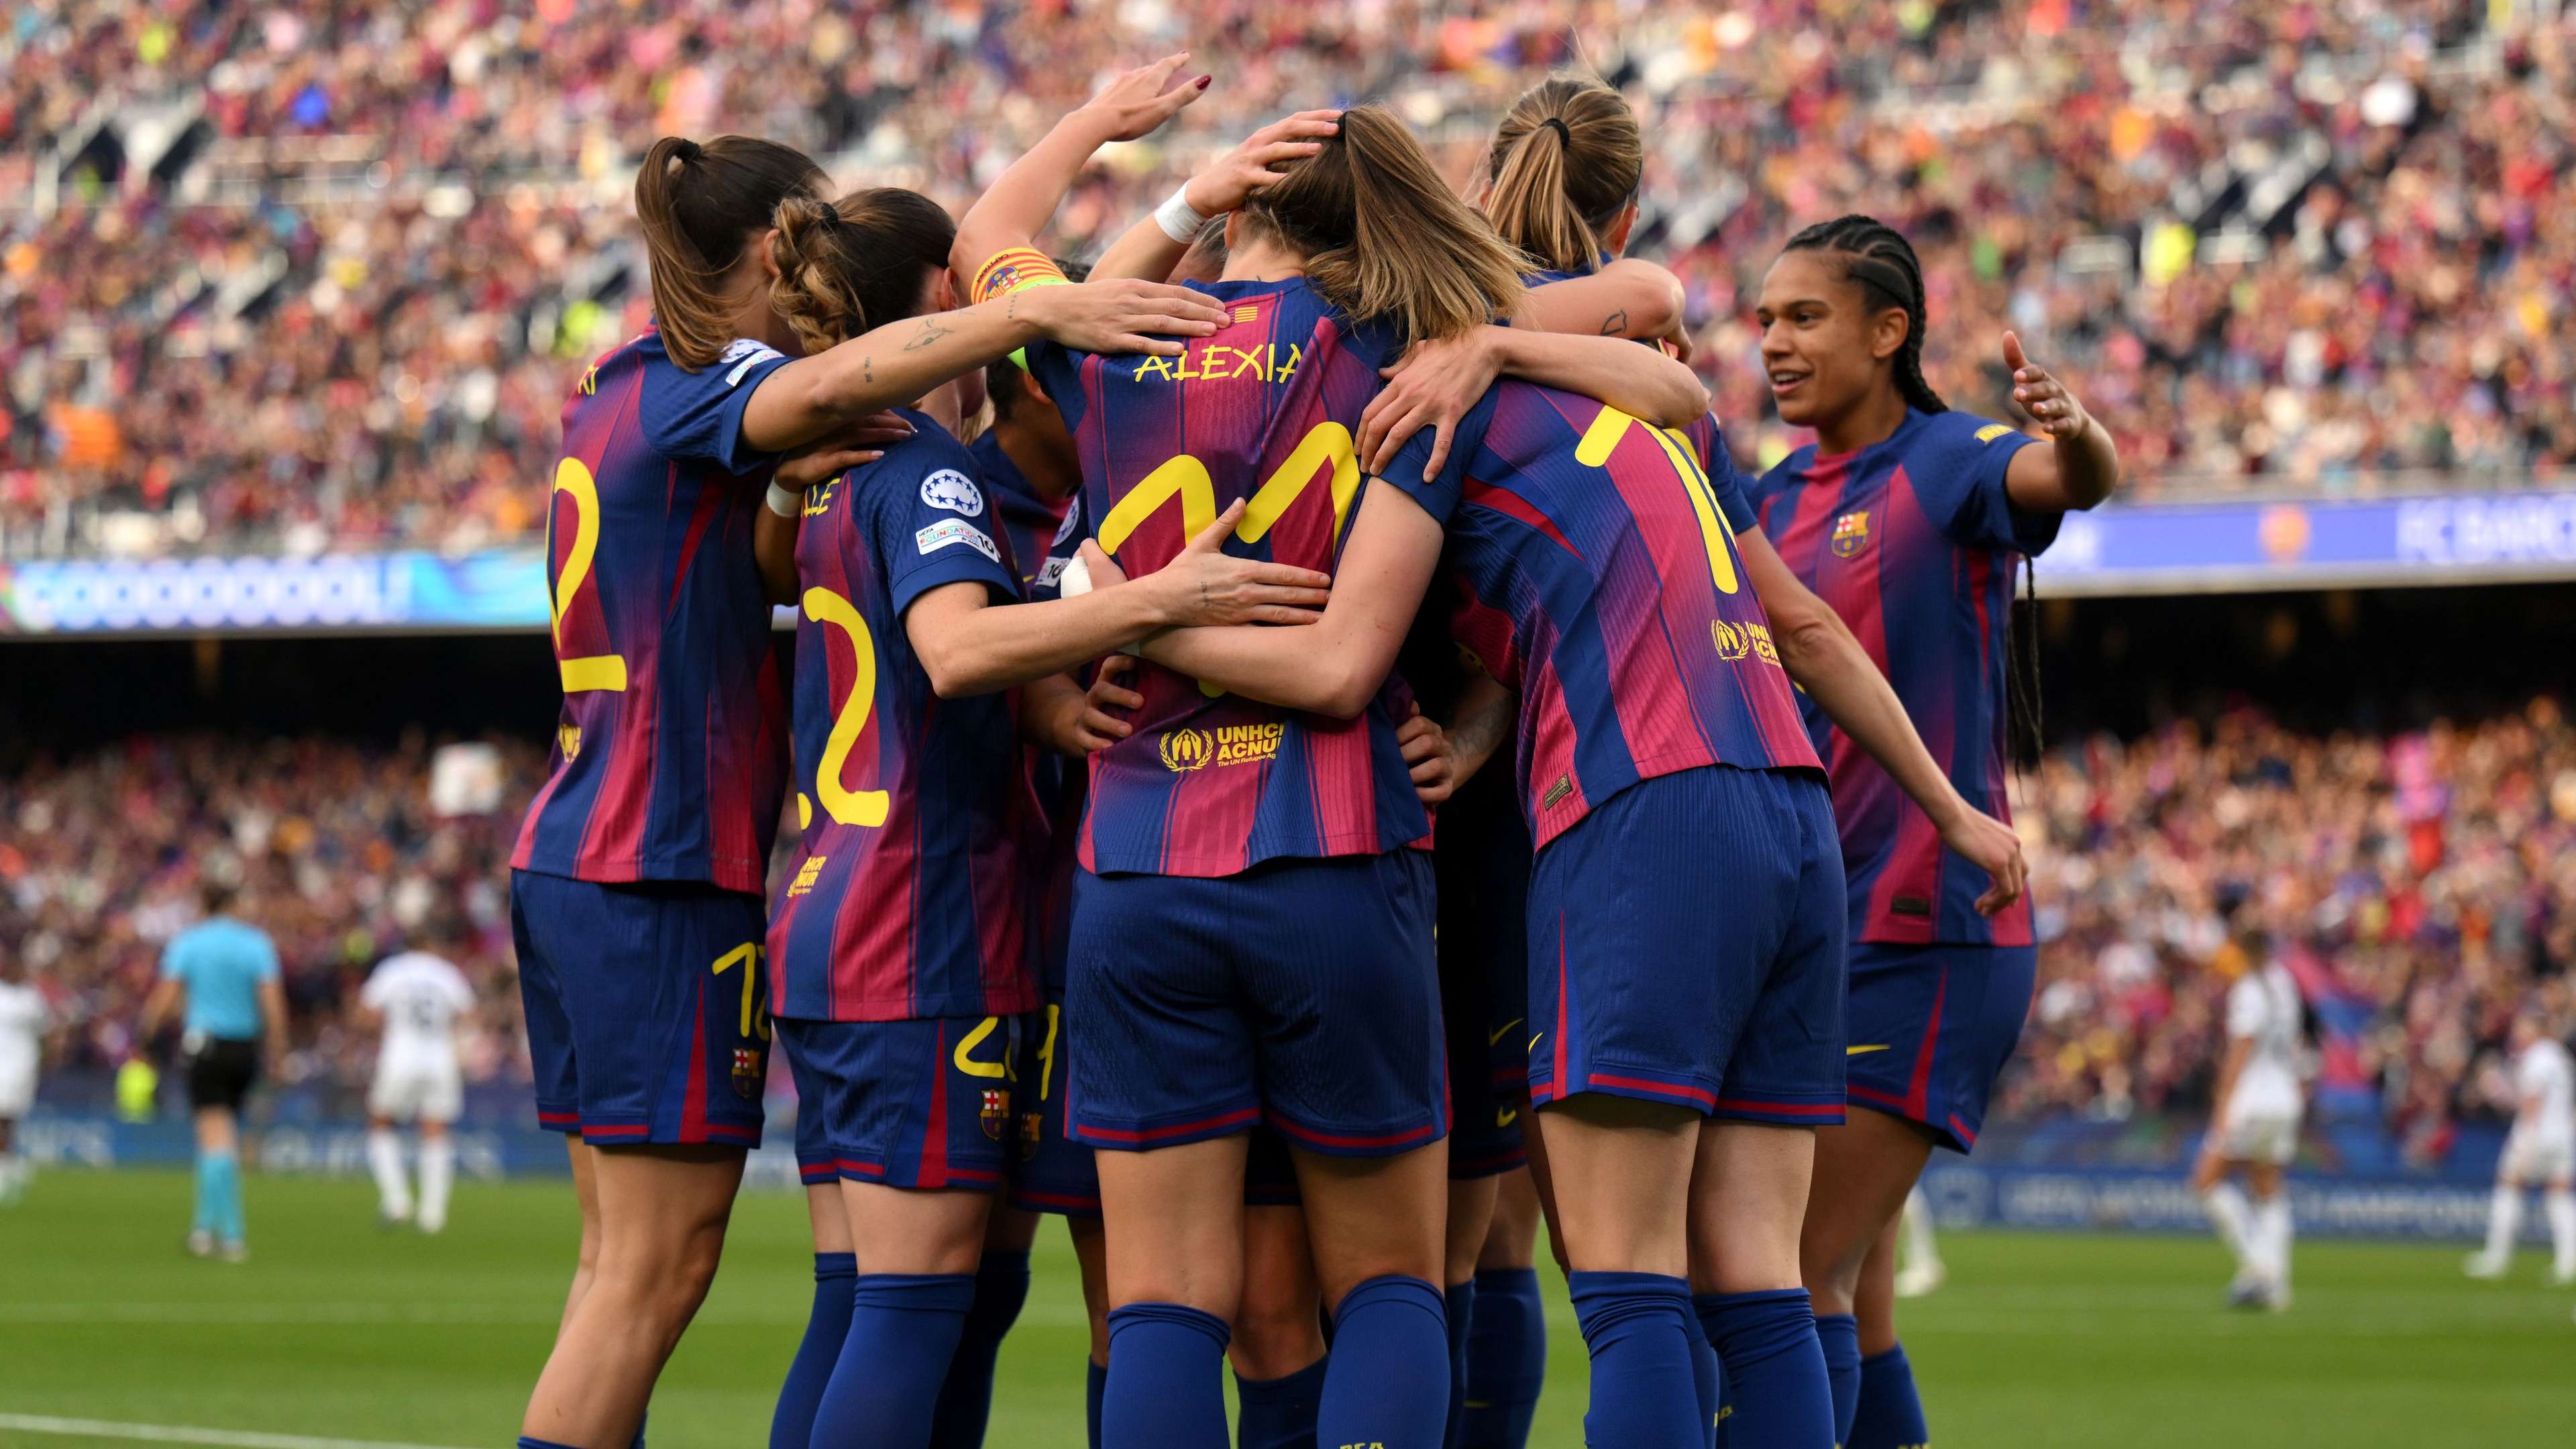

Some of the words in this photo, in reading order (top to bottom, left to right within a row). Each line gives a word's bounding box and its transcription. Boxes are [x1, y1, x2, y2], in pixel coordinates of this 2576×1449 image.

[1133, 343, 1302, 383] ALEXIA
[545, 455, 627, 693] 2
[797, 586, 890, 830] 2
[953, 1016, 1018, 1082] 2
